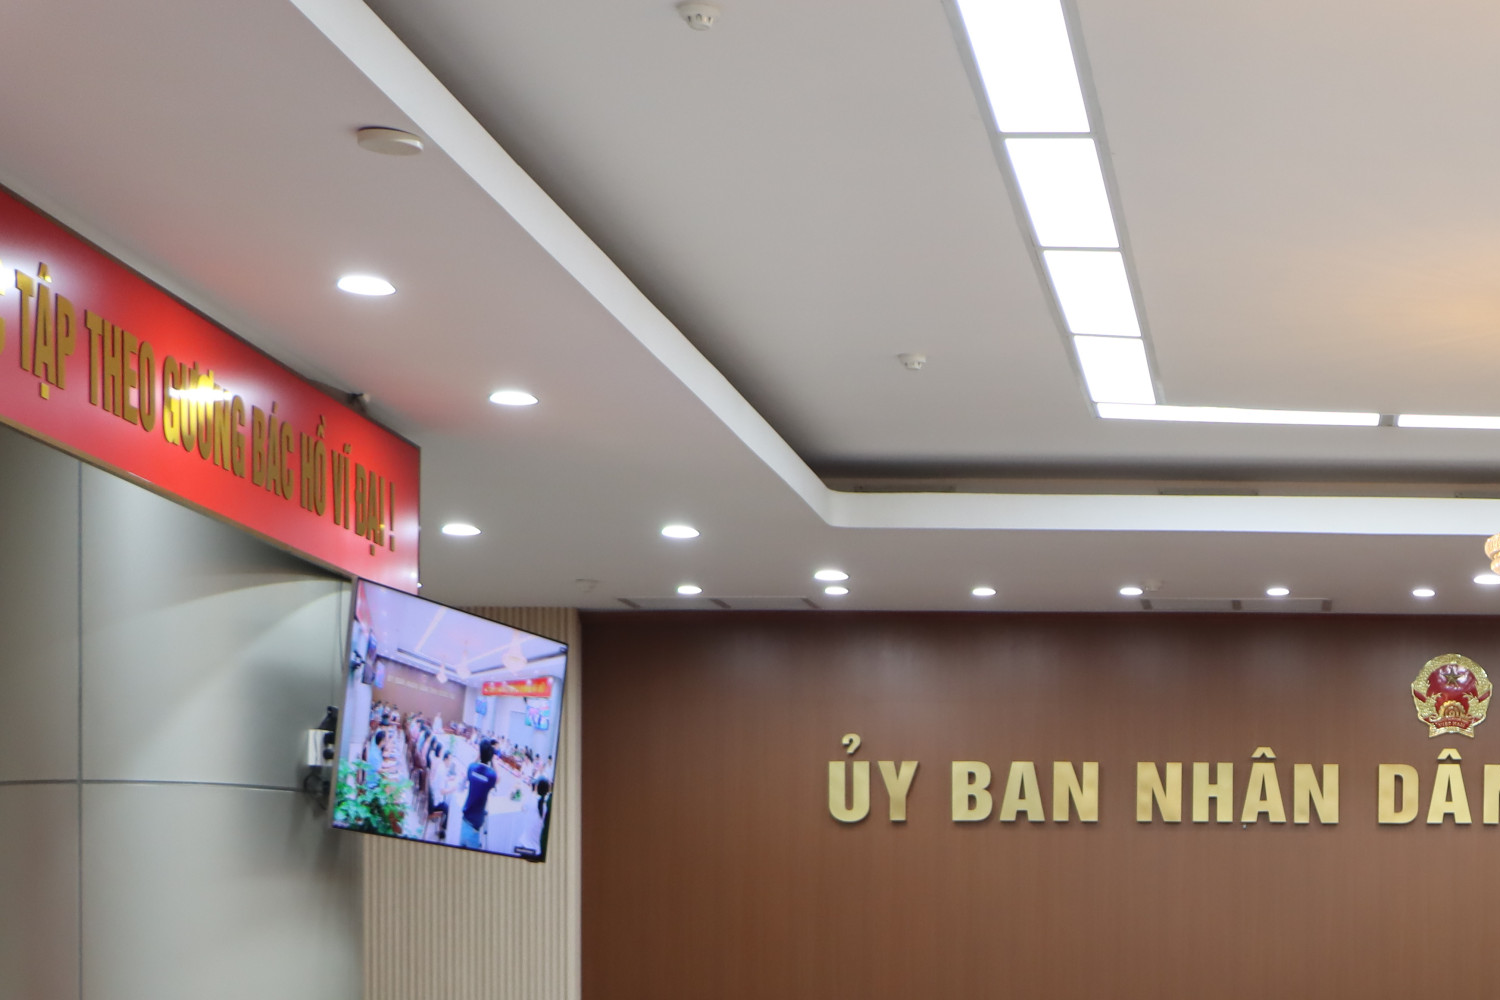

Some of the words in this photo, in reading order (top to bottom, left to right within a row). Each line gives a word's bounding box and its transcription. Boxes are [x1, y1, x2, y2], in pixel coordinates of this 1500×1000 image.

[15, 262, 76, 399] TẬP
[85, 309, 155, 432] THEO
[162, 355, 245, 478] GƯƠNG
[251, 401, 294, 500] BÁC
[300, 414, 327, 517] HỒ
[331, 443, 351, 530] VĨ
[355, 463, 385, 556] ĐẠI
[828, 733, 918, 823] ỦY
[951, 761, 1100, 823] BAN
[1136, 747, 1339, 824] NHÂN
